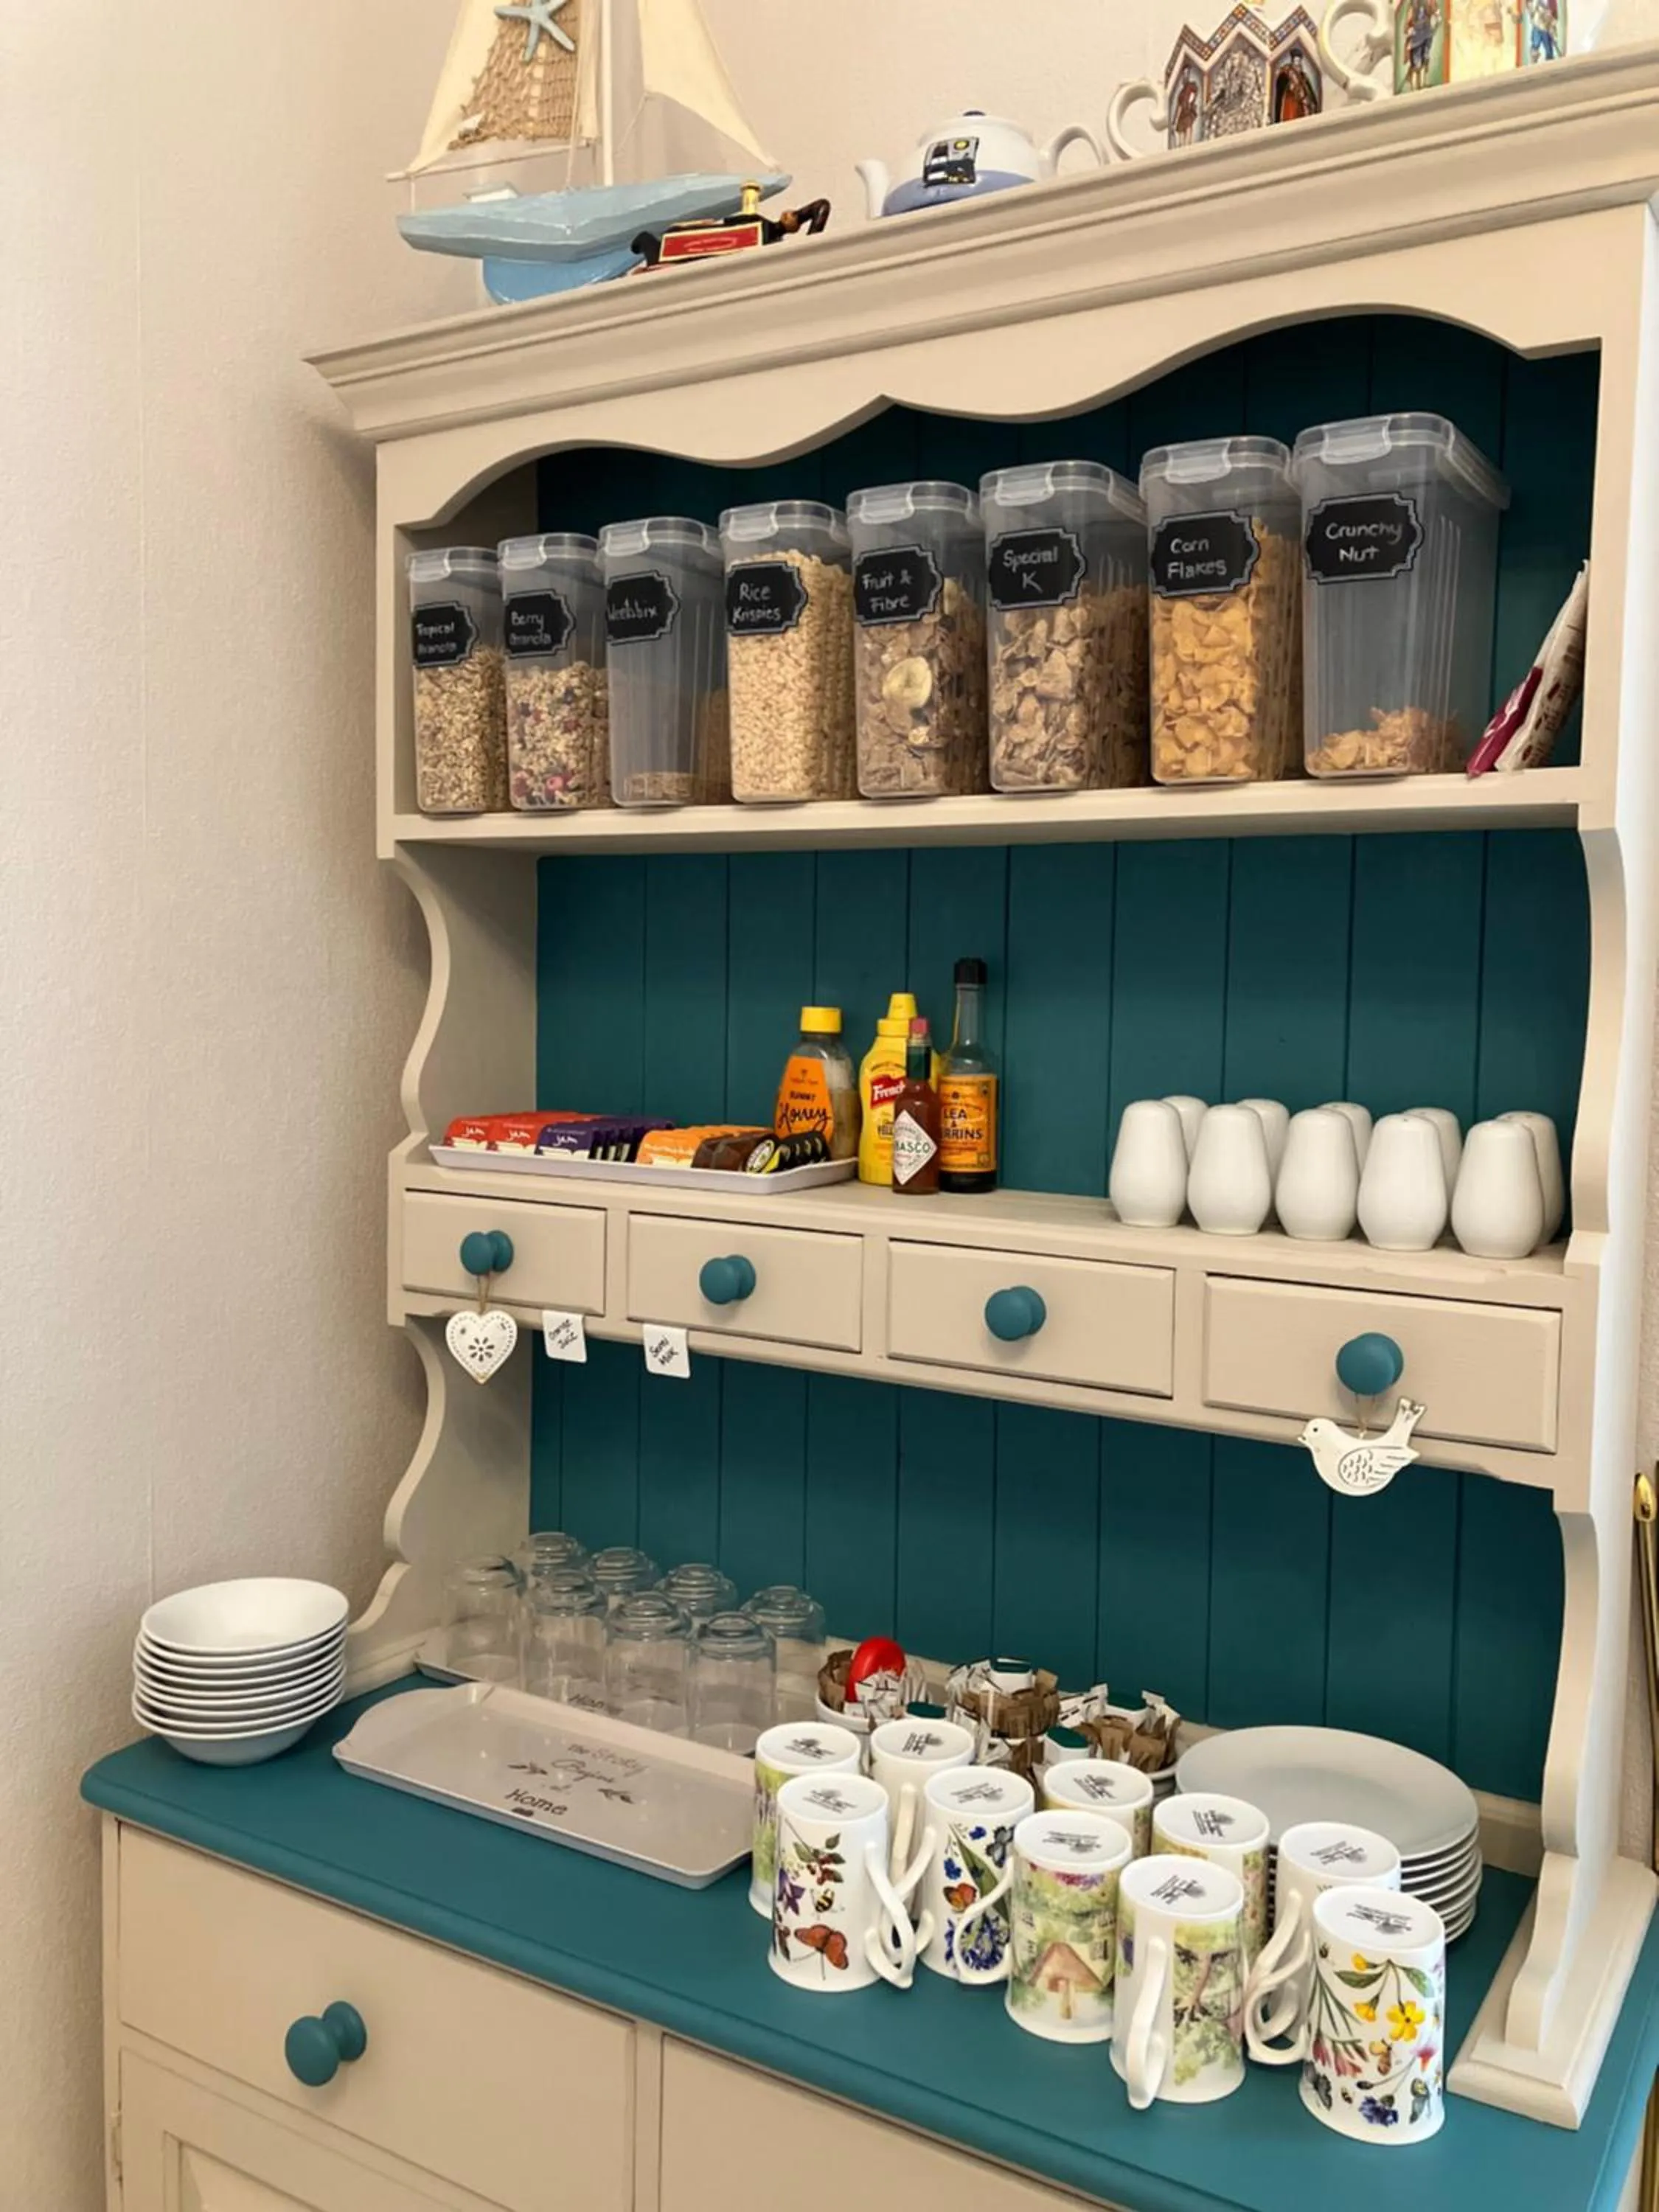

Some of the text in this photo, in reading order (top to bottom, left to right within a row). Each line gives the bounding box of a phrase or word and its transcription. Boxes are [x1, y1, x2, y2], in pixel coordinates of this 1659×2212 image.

[1326, 522, 1402, 544] Crunchy
[1170, 538, 1210, 554] Corn
[1338, 546, 1380, 563] Nut
[1002, 546, 1059, 573] Special
[1167, 559, 1228, 580] Flakes
[862, 570, 894, 590] Fruit
[1022, 571, 1043, 593] K
[739, 582, 771, 602] Rice
[511, 611, 545, 633] Berry
[943, 1108, 967, 1119] LEA
[942, 1127, 983, 1140] RRINS
[895, 1141, 931, 1154] ASCO
[504, 1788, 568, 1816] Home
